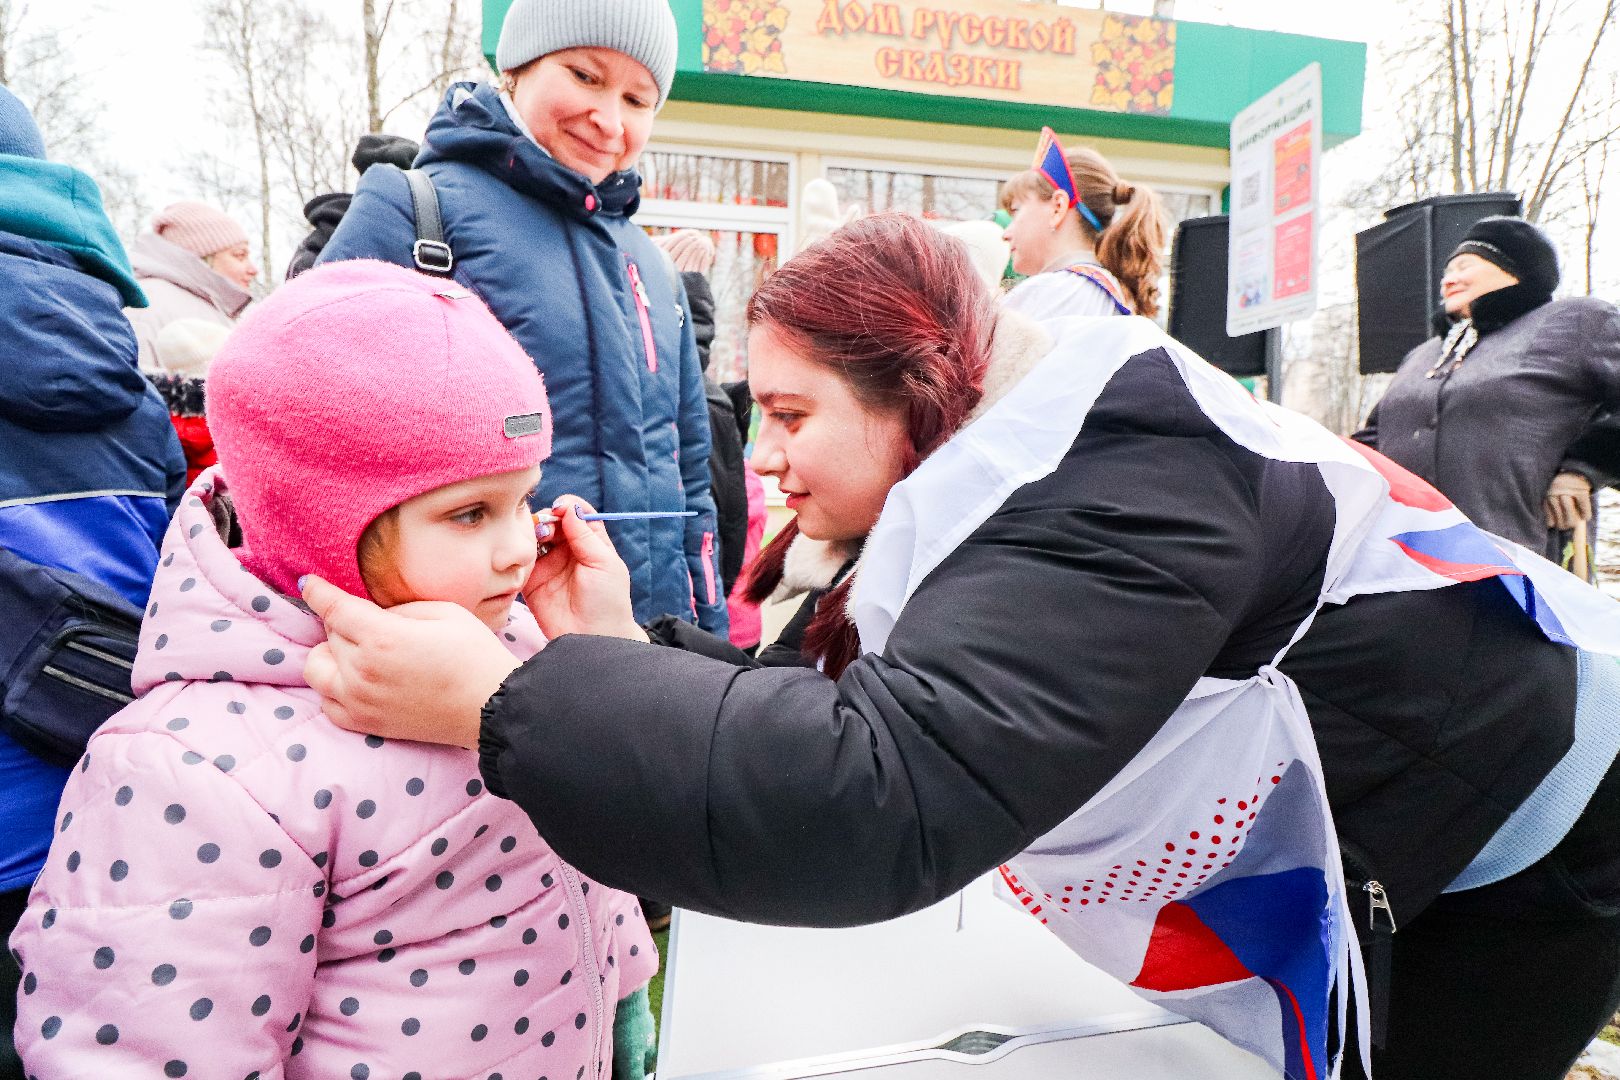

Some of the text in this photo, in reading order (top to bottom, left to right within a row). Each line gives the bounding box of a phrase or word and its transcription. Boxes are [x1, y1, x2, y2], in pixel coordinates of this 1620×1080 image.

[815, 0, 1077, 54] ДОМ РУССКОЙ
[875, 47, 1022, 90] СКАЗКИ
